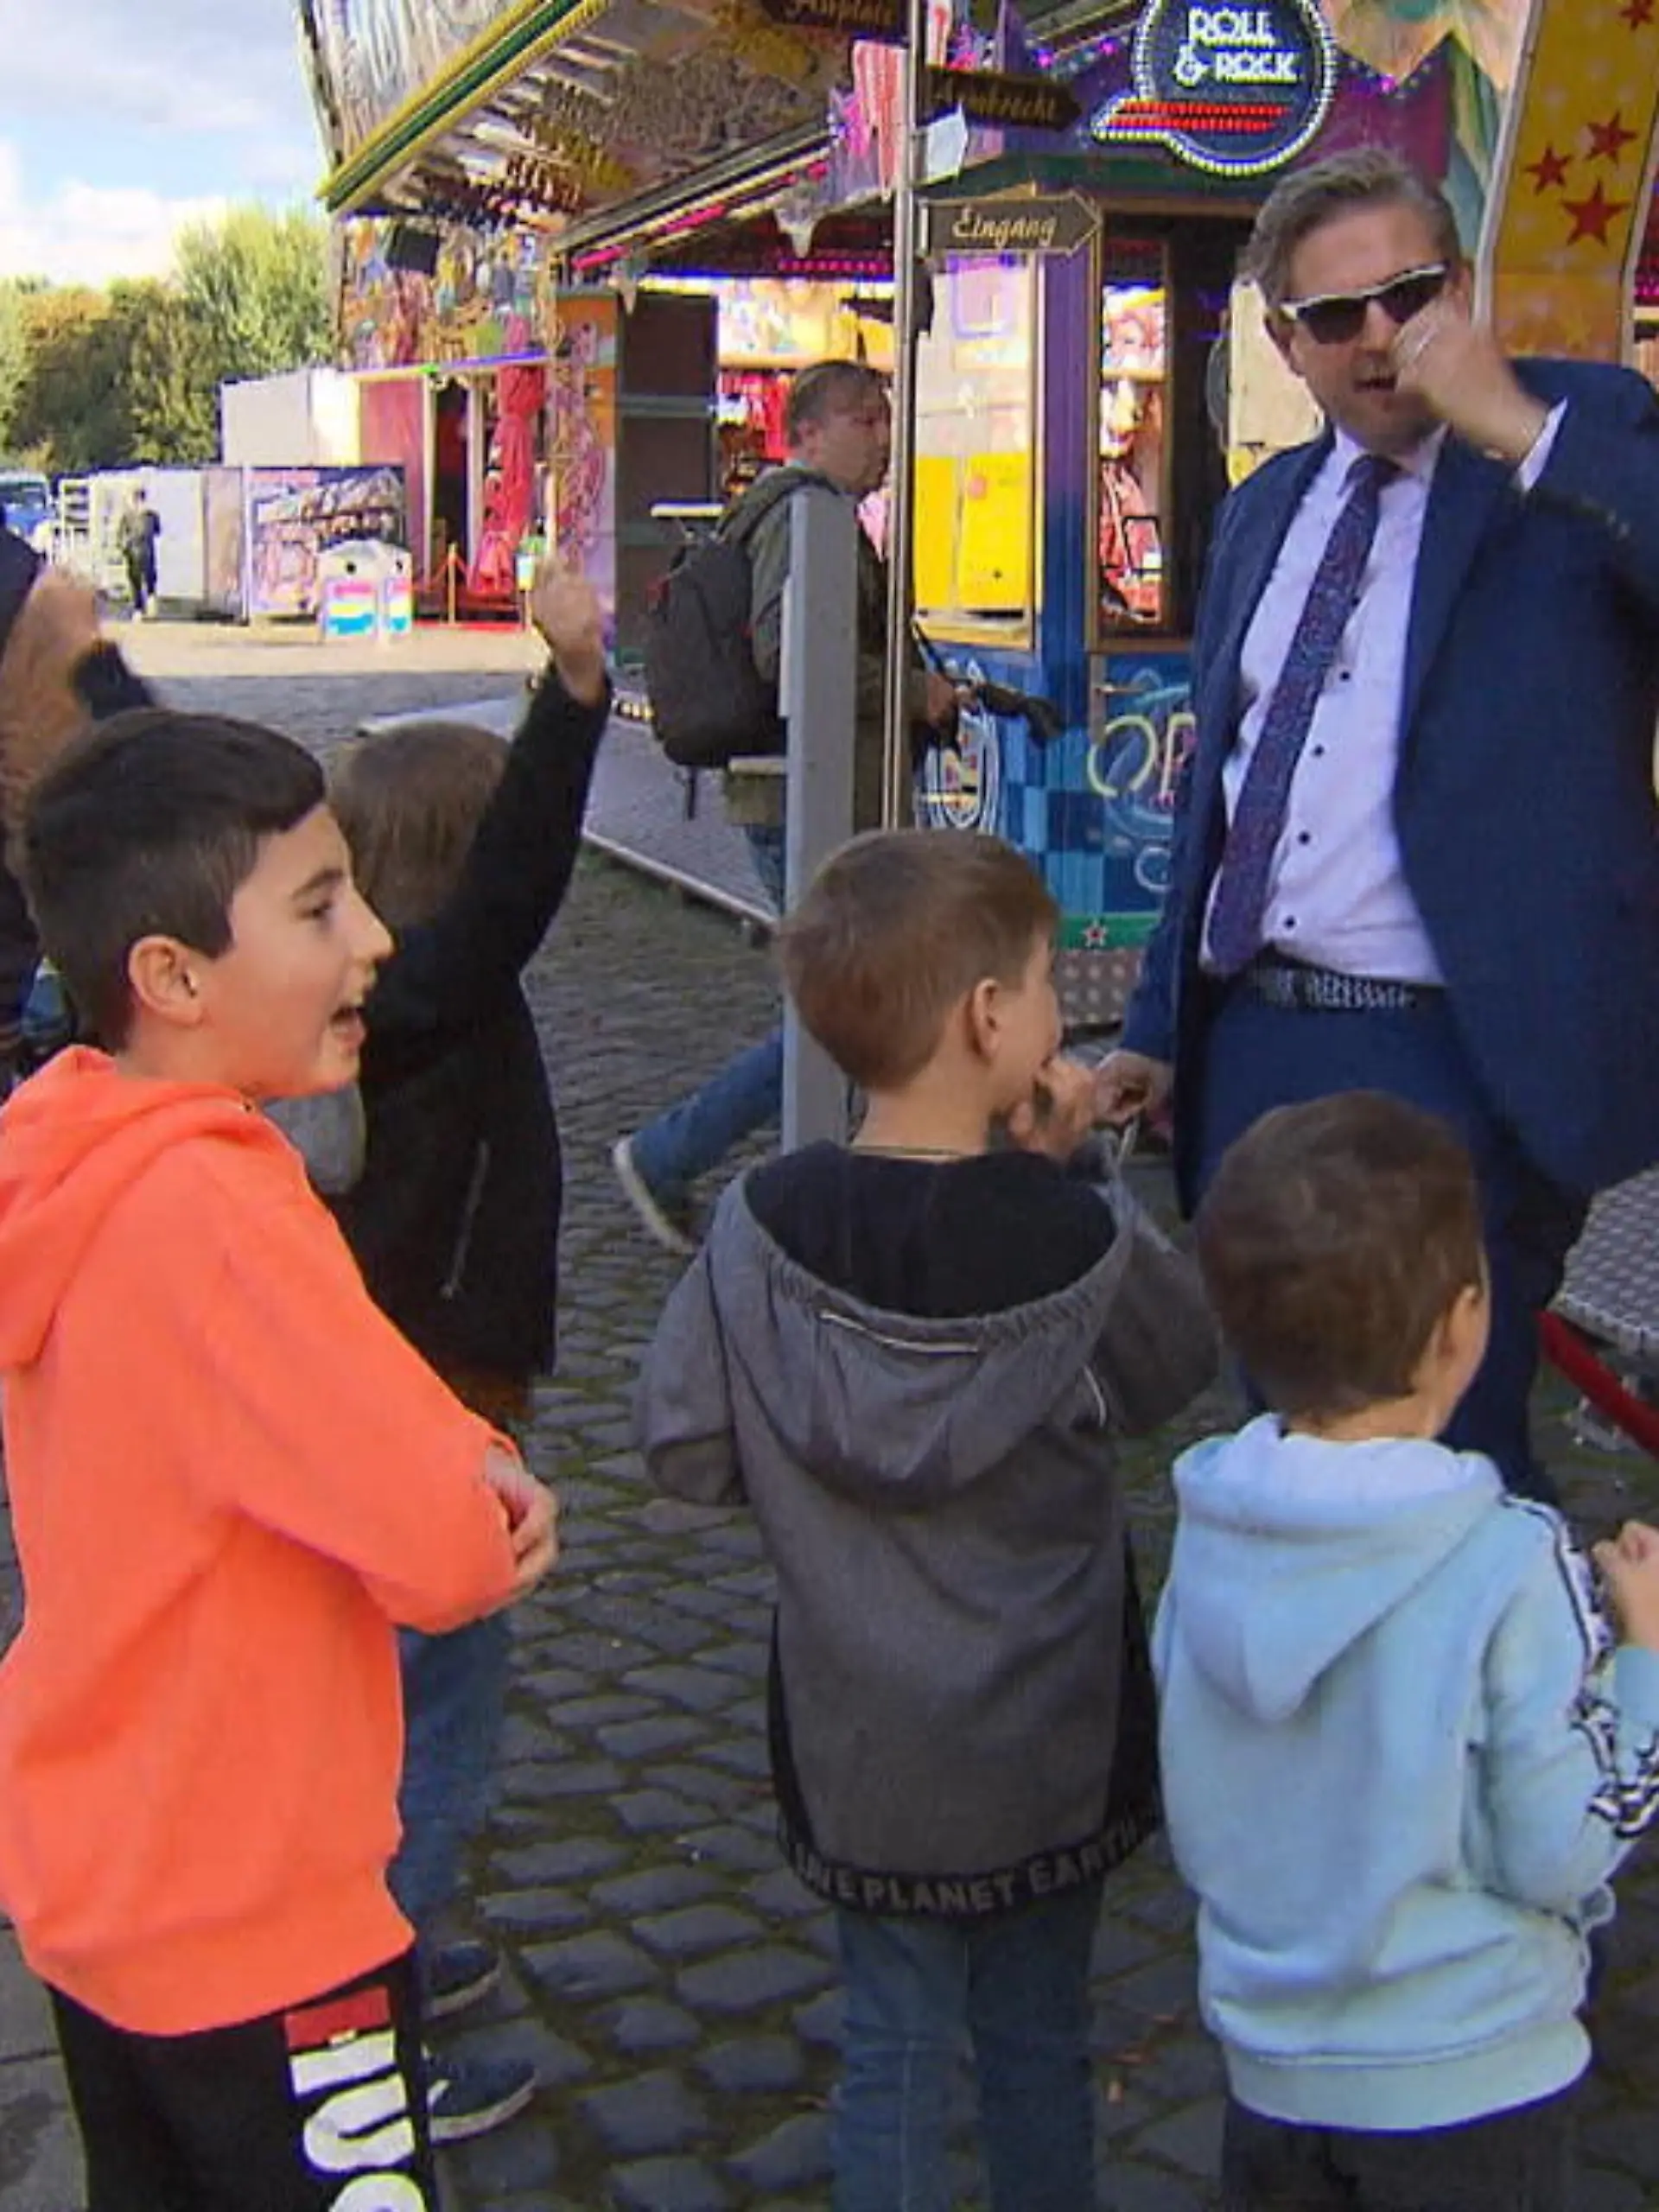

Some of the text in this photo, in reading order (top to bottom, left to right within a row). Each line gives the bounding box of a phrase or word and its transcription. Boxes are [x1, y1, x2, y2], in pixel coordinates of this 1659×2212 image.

[1188, 7, 1275, 47] ROLL
[1173, 43, 1298, 87] & ROCK
[951, 203, 1057, 251] Eingang
[864, 1872, 1016, 1911] PLANET
[1027, 1819, 1138, 1894] EARTH
